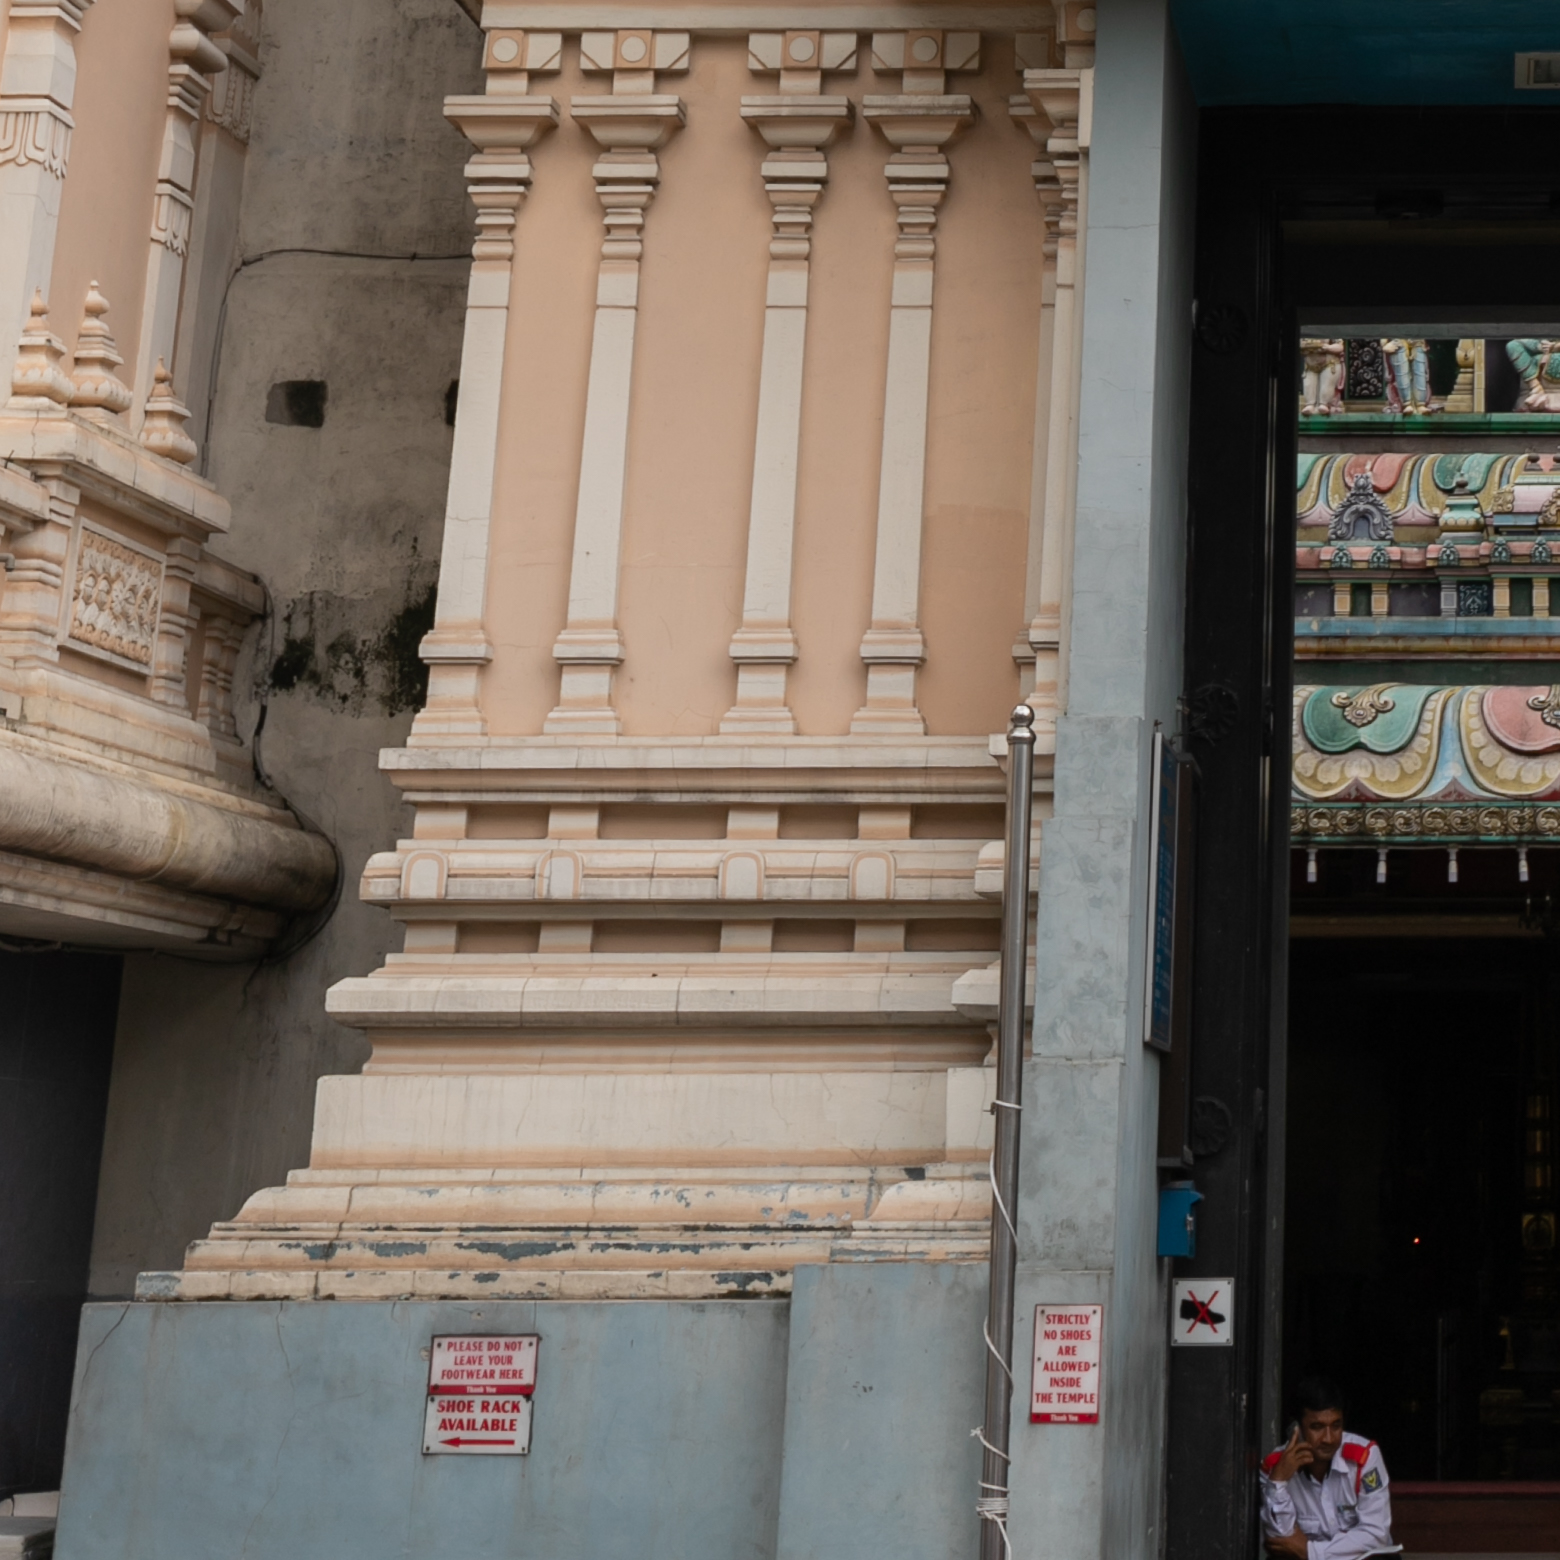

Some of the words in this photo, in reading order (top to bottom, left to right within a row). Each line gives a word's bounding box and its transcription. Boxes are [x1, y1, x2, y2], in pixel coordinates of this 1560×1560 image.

[1045, 1314, 1090, 1325] STRICTLY
[1044, 1330, 1057, 1340] NO
[1060, 1330, 1091, 1340] SHOES
[447, 1342, 483, 1351] PLEASE
[487, 1342, 501, 1351] DO
[504, 1341, 522, 1351] NOT
[1057, 1346, 1077, 1356] ARE
[454, 1356, 483, 1365] LEAVE
[488, 1355, 513, 1365] YOUR
[1043, 1362, 1090, 1372] ALLOWED
[441, 1370, 495, 1380] FOOTWEAR
[499, 1369, 524, 1379] HERE
[1050, 1377, 1081, 1387] INSIDE
[1035, 1393, 1053, 1403] THE
[1056, 1393, 1095, 1403] TEMPLE
[437, 1401, 474, 1413] SHOE
[480, 1401, 521, 1413] RACK
[438, 1419, 517, 1431] AVAILABLE
